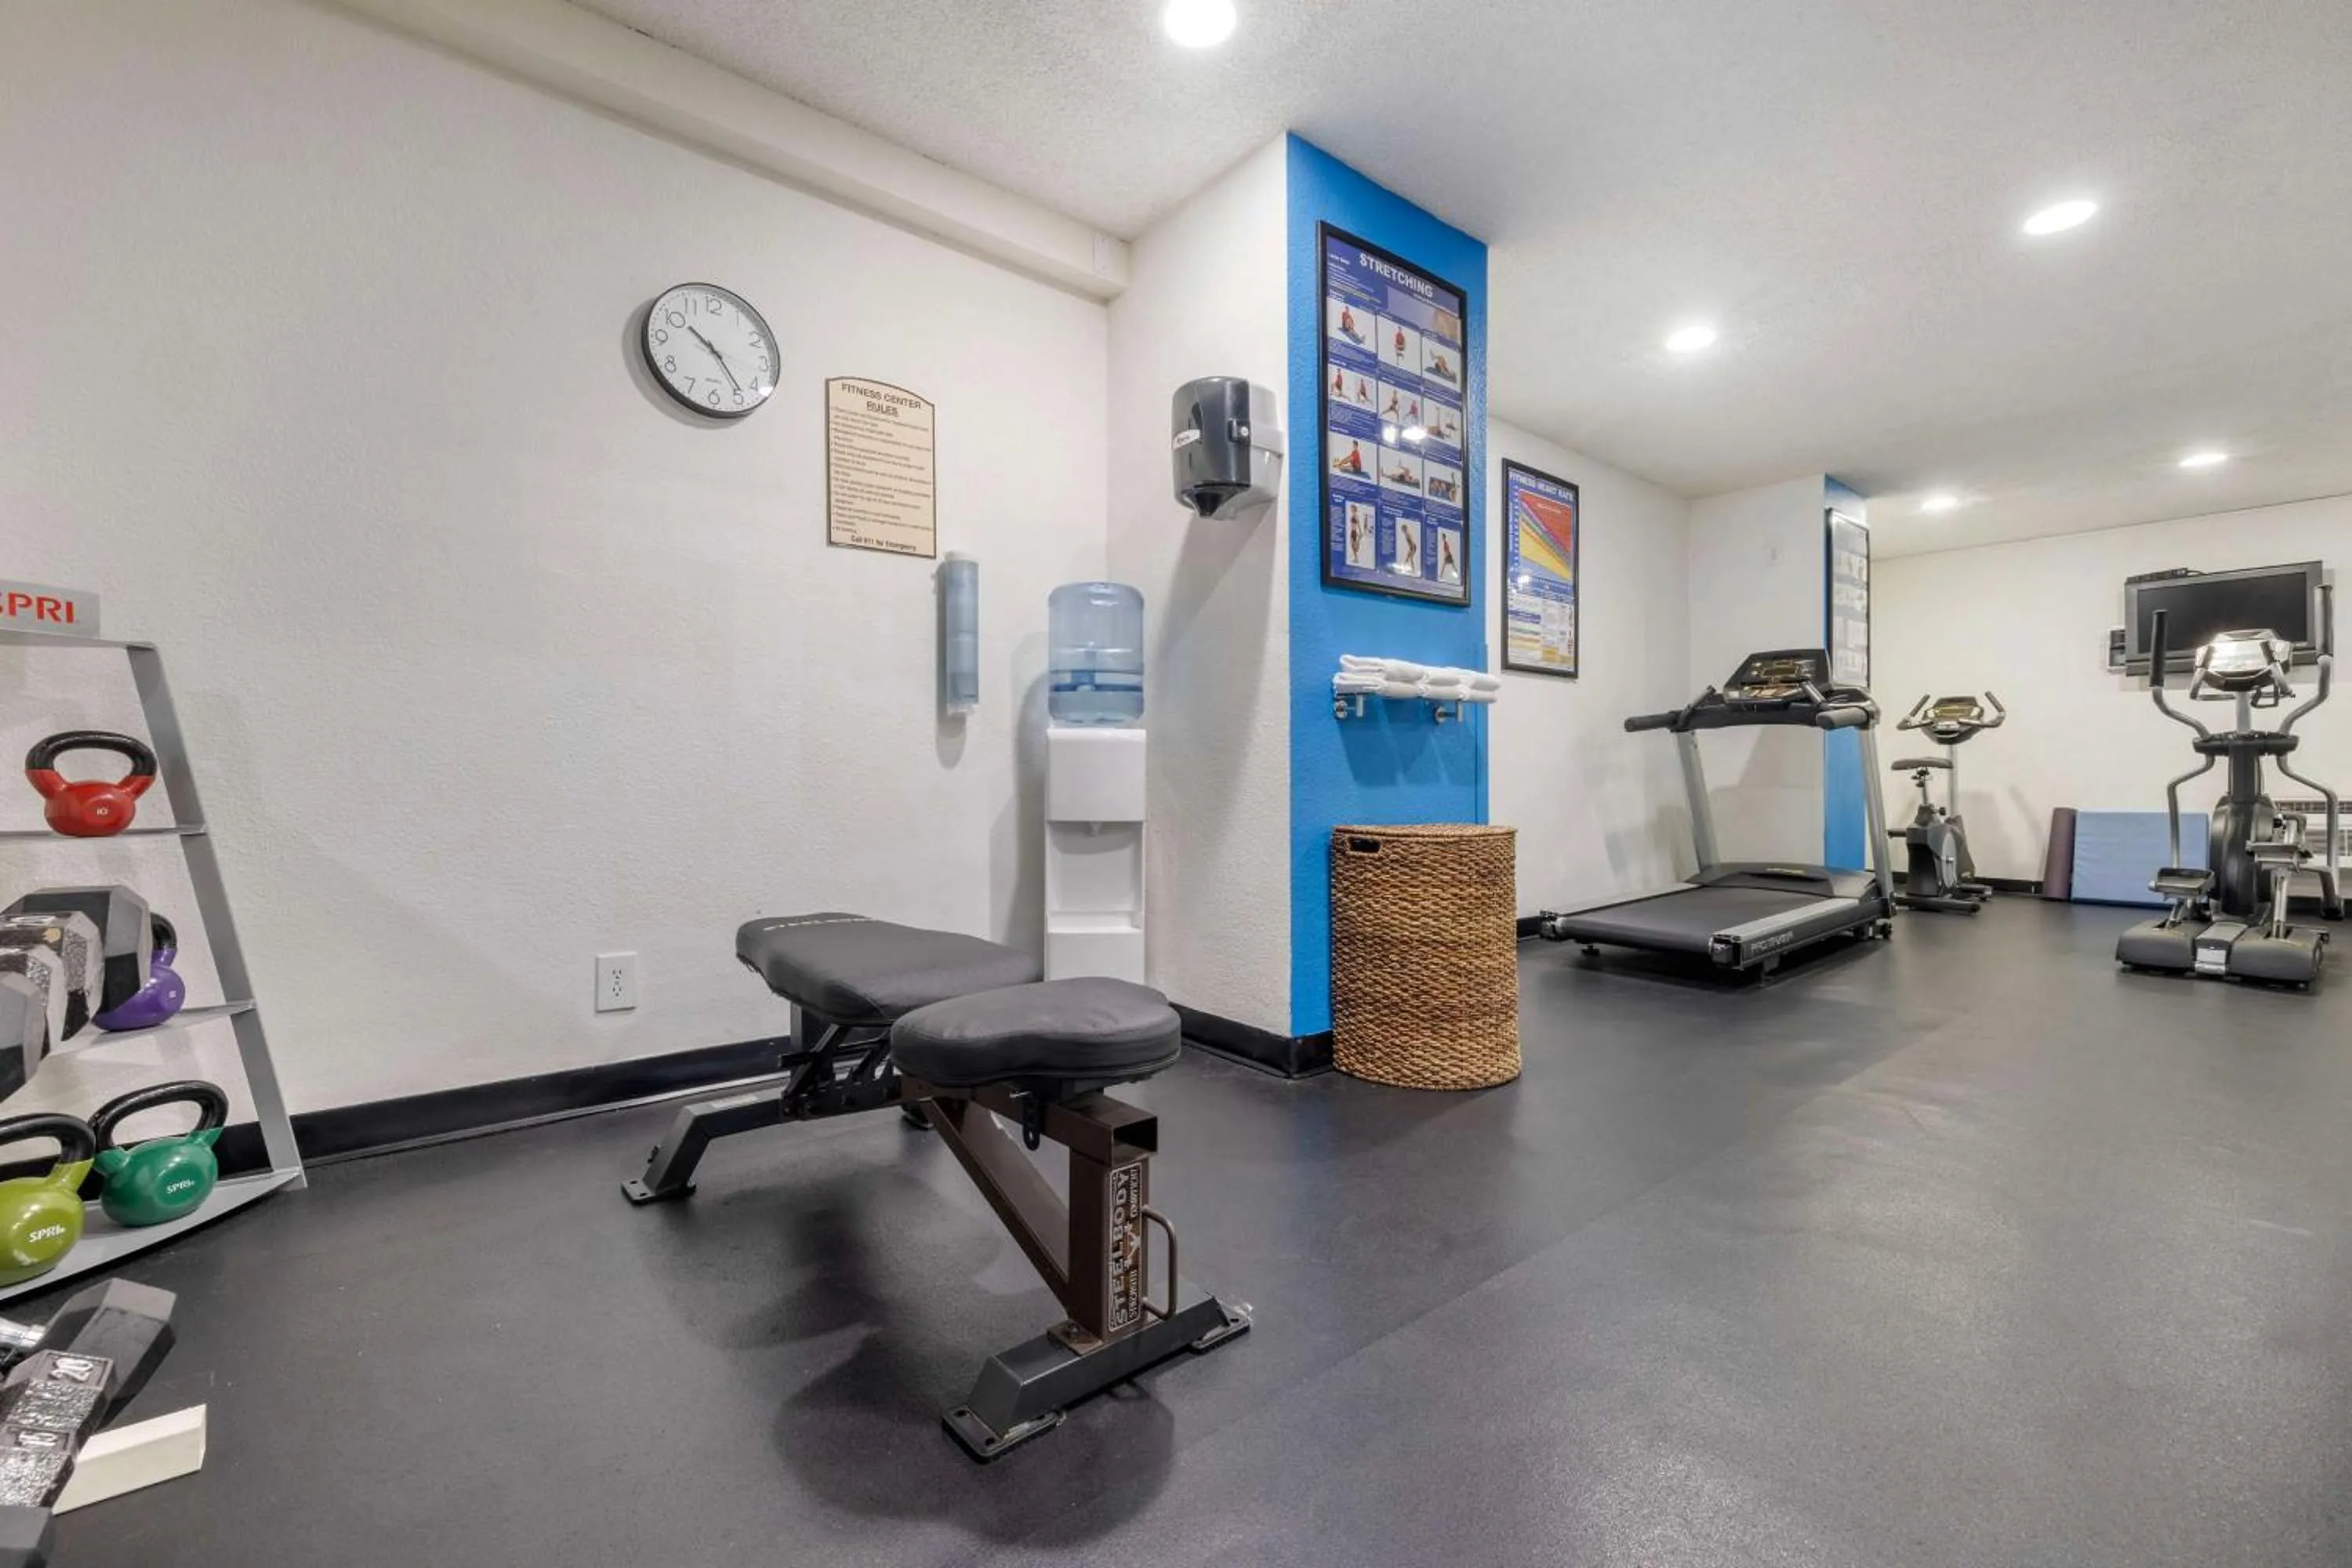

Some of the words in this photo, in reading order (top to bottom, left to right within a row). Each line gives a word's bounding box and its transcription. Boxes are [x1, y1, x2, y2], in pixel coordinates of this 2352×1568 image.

[1359, 252, 1433, 299] STRETCHING
[684, 298, 697, 317] 11
[706, 296, 722, 316] 12
[666, 308, 686, 328] 10
[655, 328, 668, 346] 9
[749, 330, 766, 348] 2
[664, 354, 677, 373] 8
[758, 355, 768, 372] 3
[684, 376, 695, 393] 7
[750, 376, 759, 392] 4
[708, 388, 720, 405] 6
[732, 388, 744, 405] 5
[841, 382, 882, 401] FITNESS
[884, 393, 921, 409] CENTER
[866, 401, 899, 417] RULES
[0, 592, 74, 623] PRI
[166, 1178, 191, 1194] SPRI
[29, 1224, 62, 1243] SPRI
[1112, 1171, 1129, 1324] STEELBODY
[49, 1357, 93, 1381] 20
